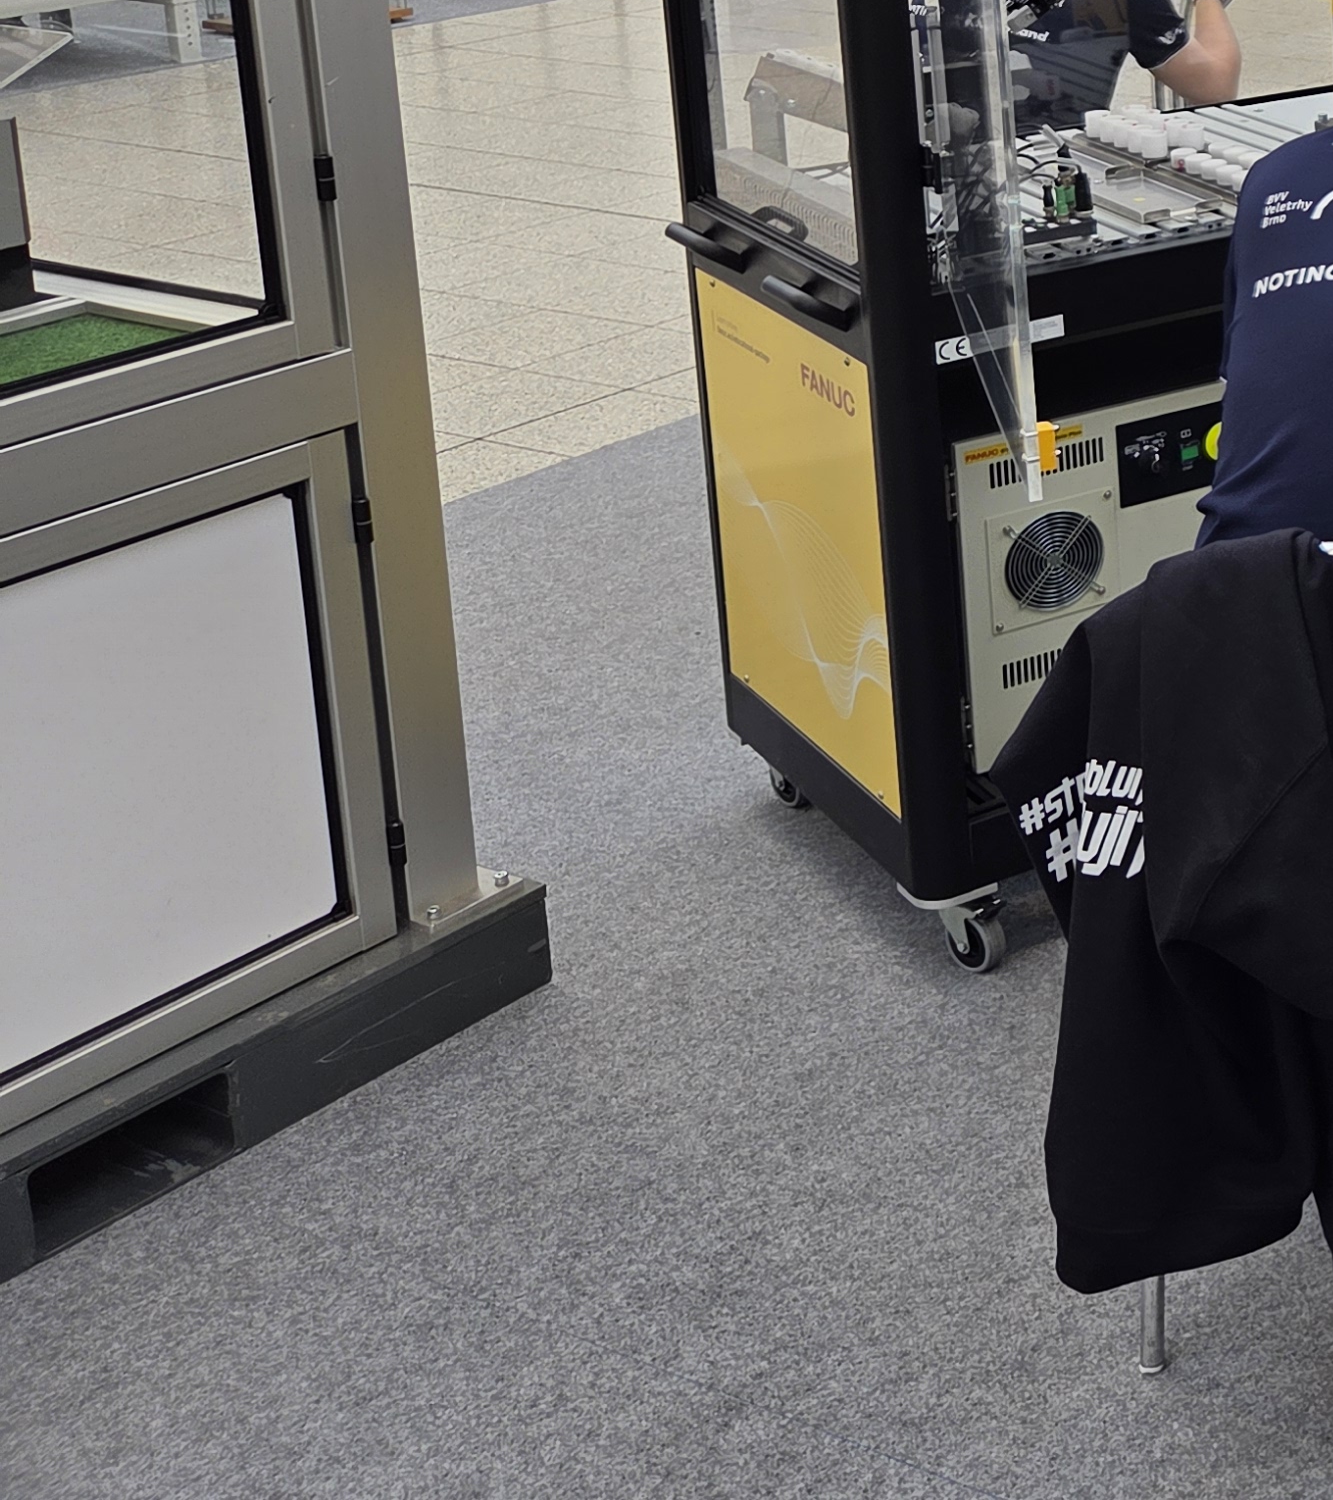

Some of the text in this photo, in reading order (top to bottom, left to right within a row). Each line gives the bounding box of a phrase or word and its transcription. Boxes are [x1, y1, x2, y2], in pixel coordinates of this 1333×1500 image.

[1263, 198, 1313, 217] Veletrhy
[1260, 212, 1288, 229] Brno
[800, 362, 856, 418] FANUC
